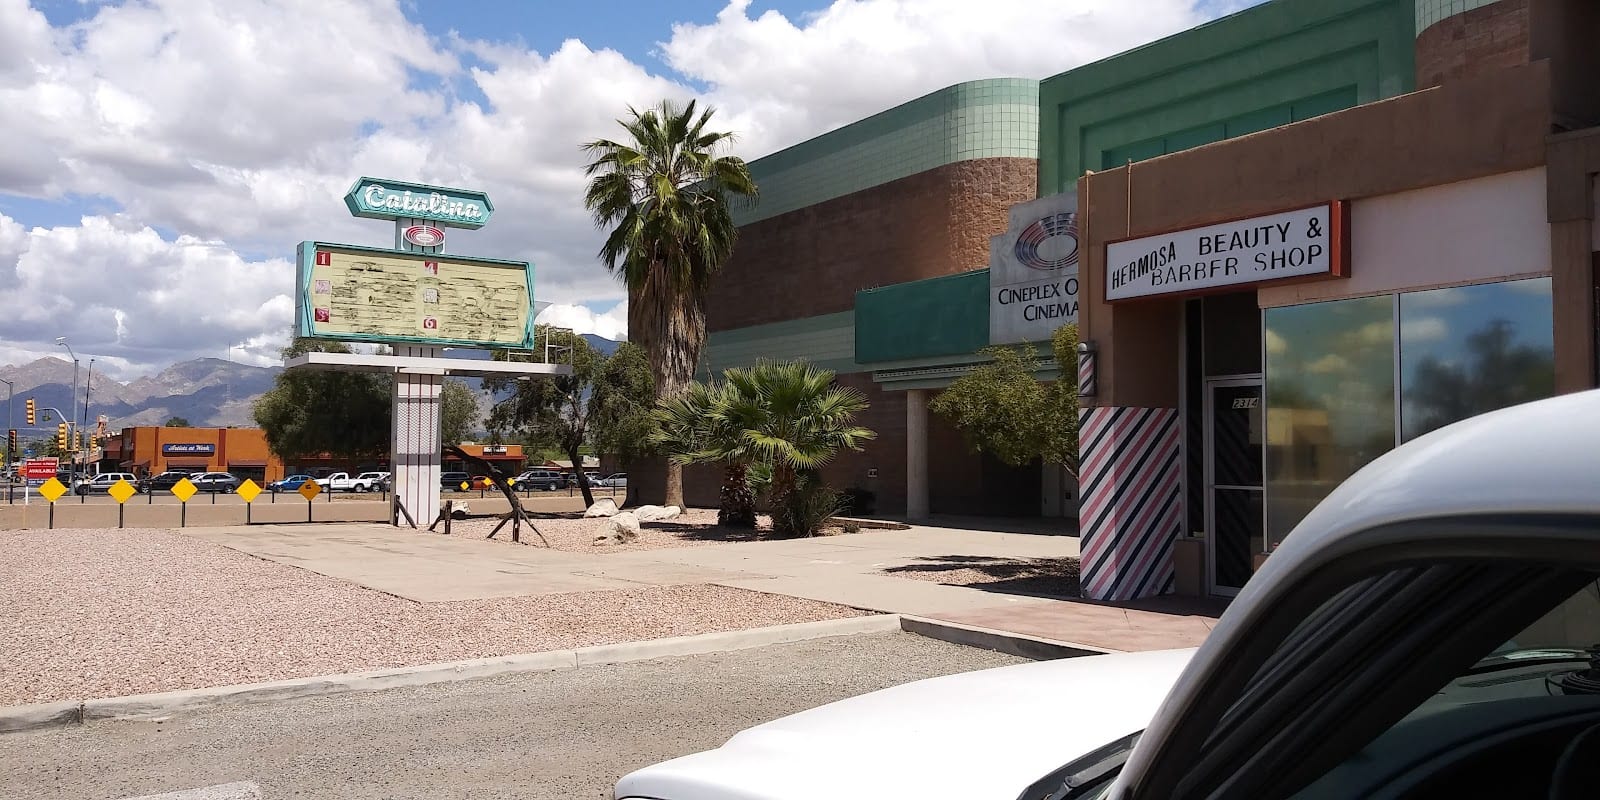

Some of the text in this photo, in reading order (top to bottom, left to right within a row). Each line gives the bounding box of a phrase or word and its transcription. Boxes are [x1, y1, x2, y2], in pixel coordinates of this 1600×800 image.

[364, 184, 482, 218] Catalina
[1112, 217, 1322, 290] HERMOSA BEAUTY &
[1254, 244, 1322, 272] SHOP
[998, 283, 1061, 305] CINEPLEX
[1233, 398, 1259, 408] 2314
